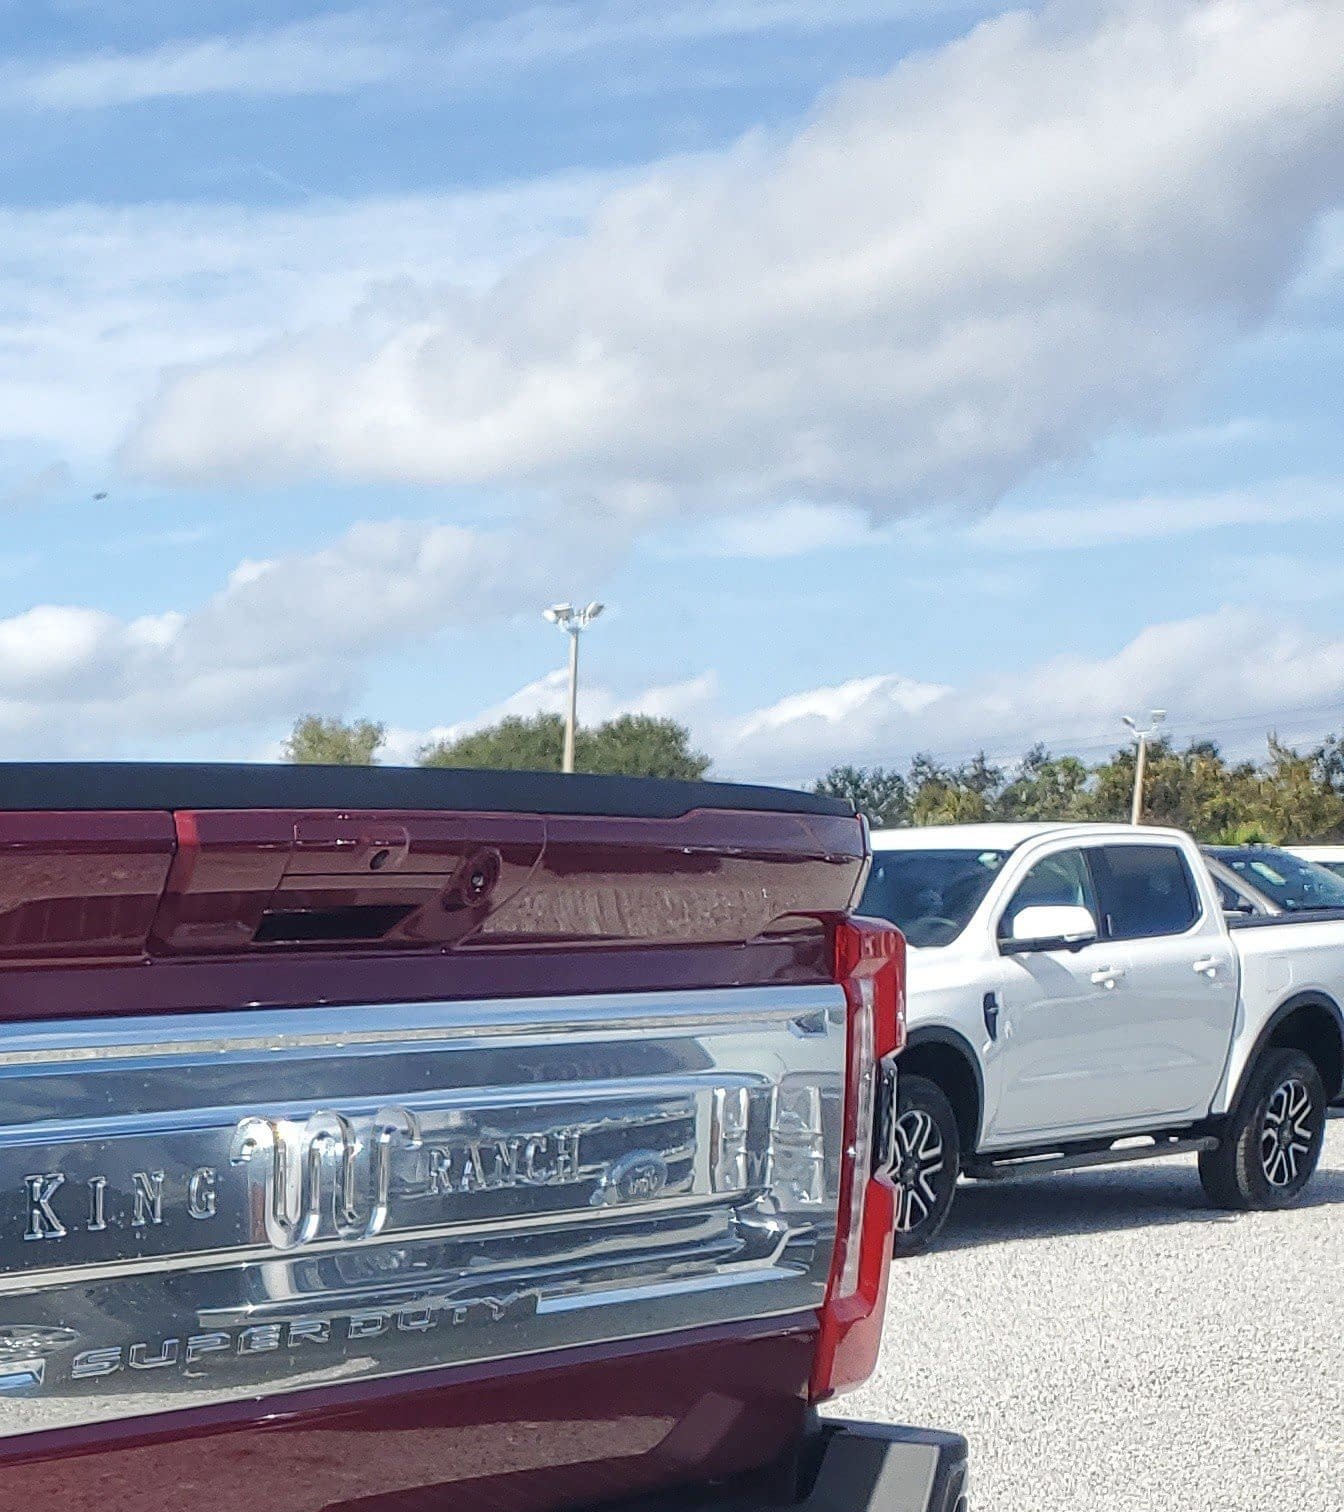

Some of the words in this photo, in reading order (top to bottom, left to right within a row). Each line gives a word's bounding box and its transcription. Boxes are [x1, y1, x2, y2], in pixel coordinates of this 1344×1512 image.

[22, 1166, 218, 1241] KING
[426, 1129, 583, 1195] RANCH
[71, 1318, 331, 1380] SUPER
[346, 1290, 524, 1341] DUTY
